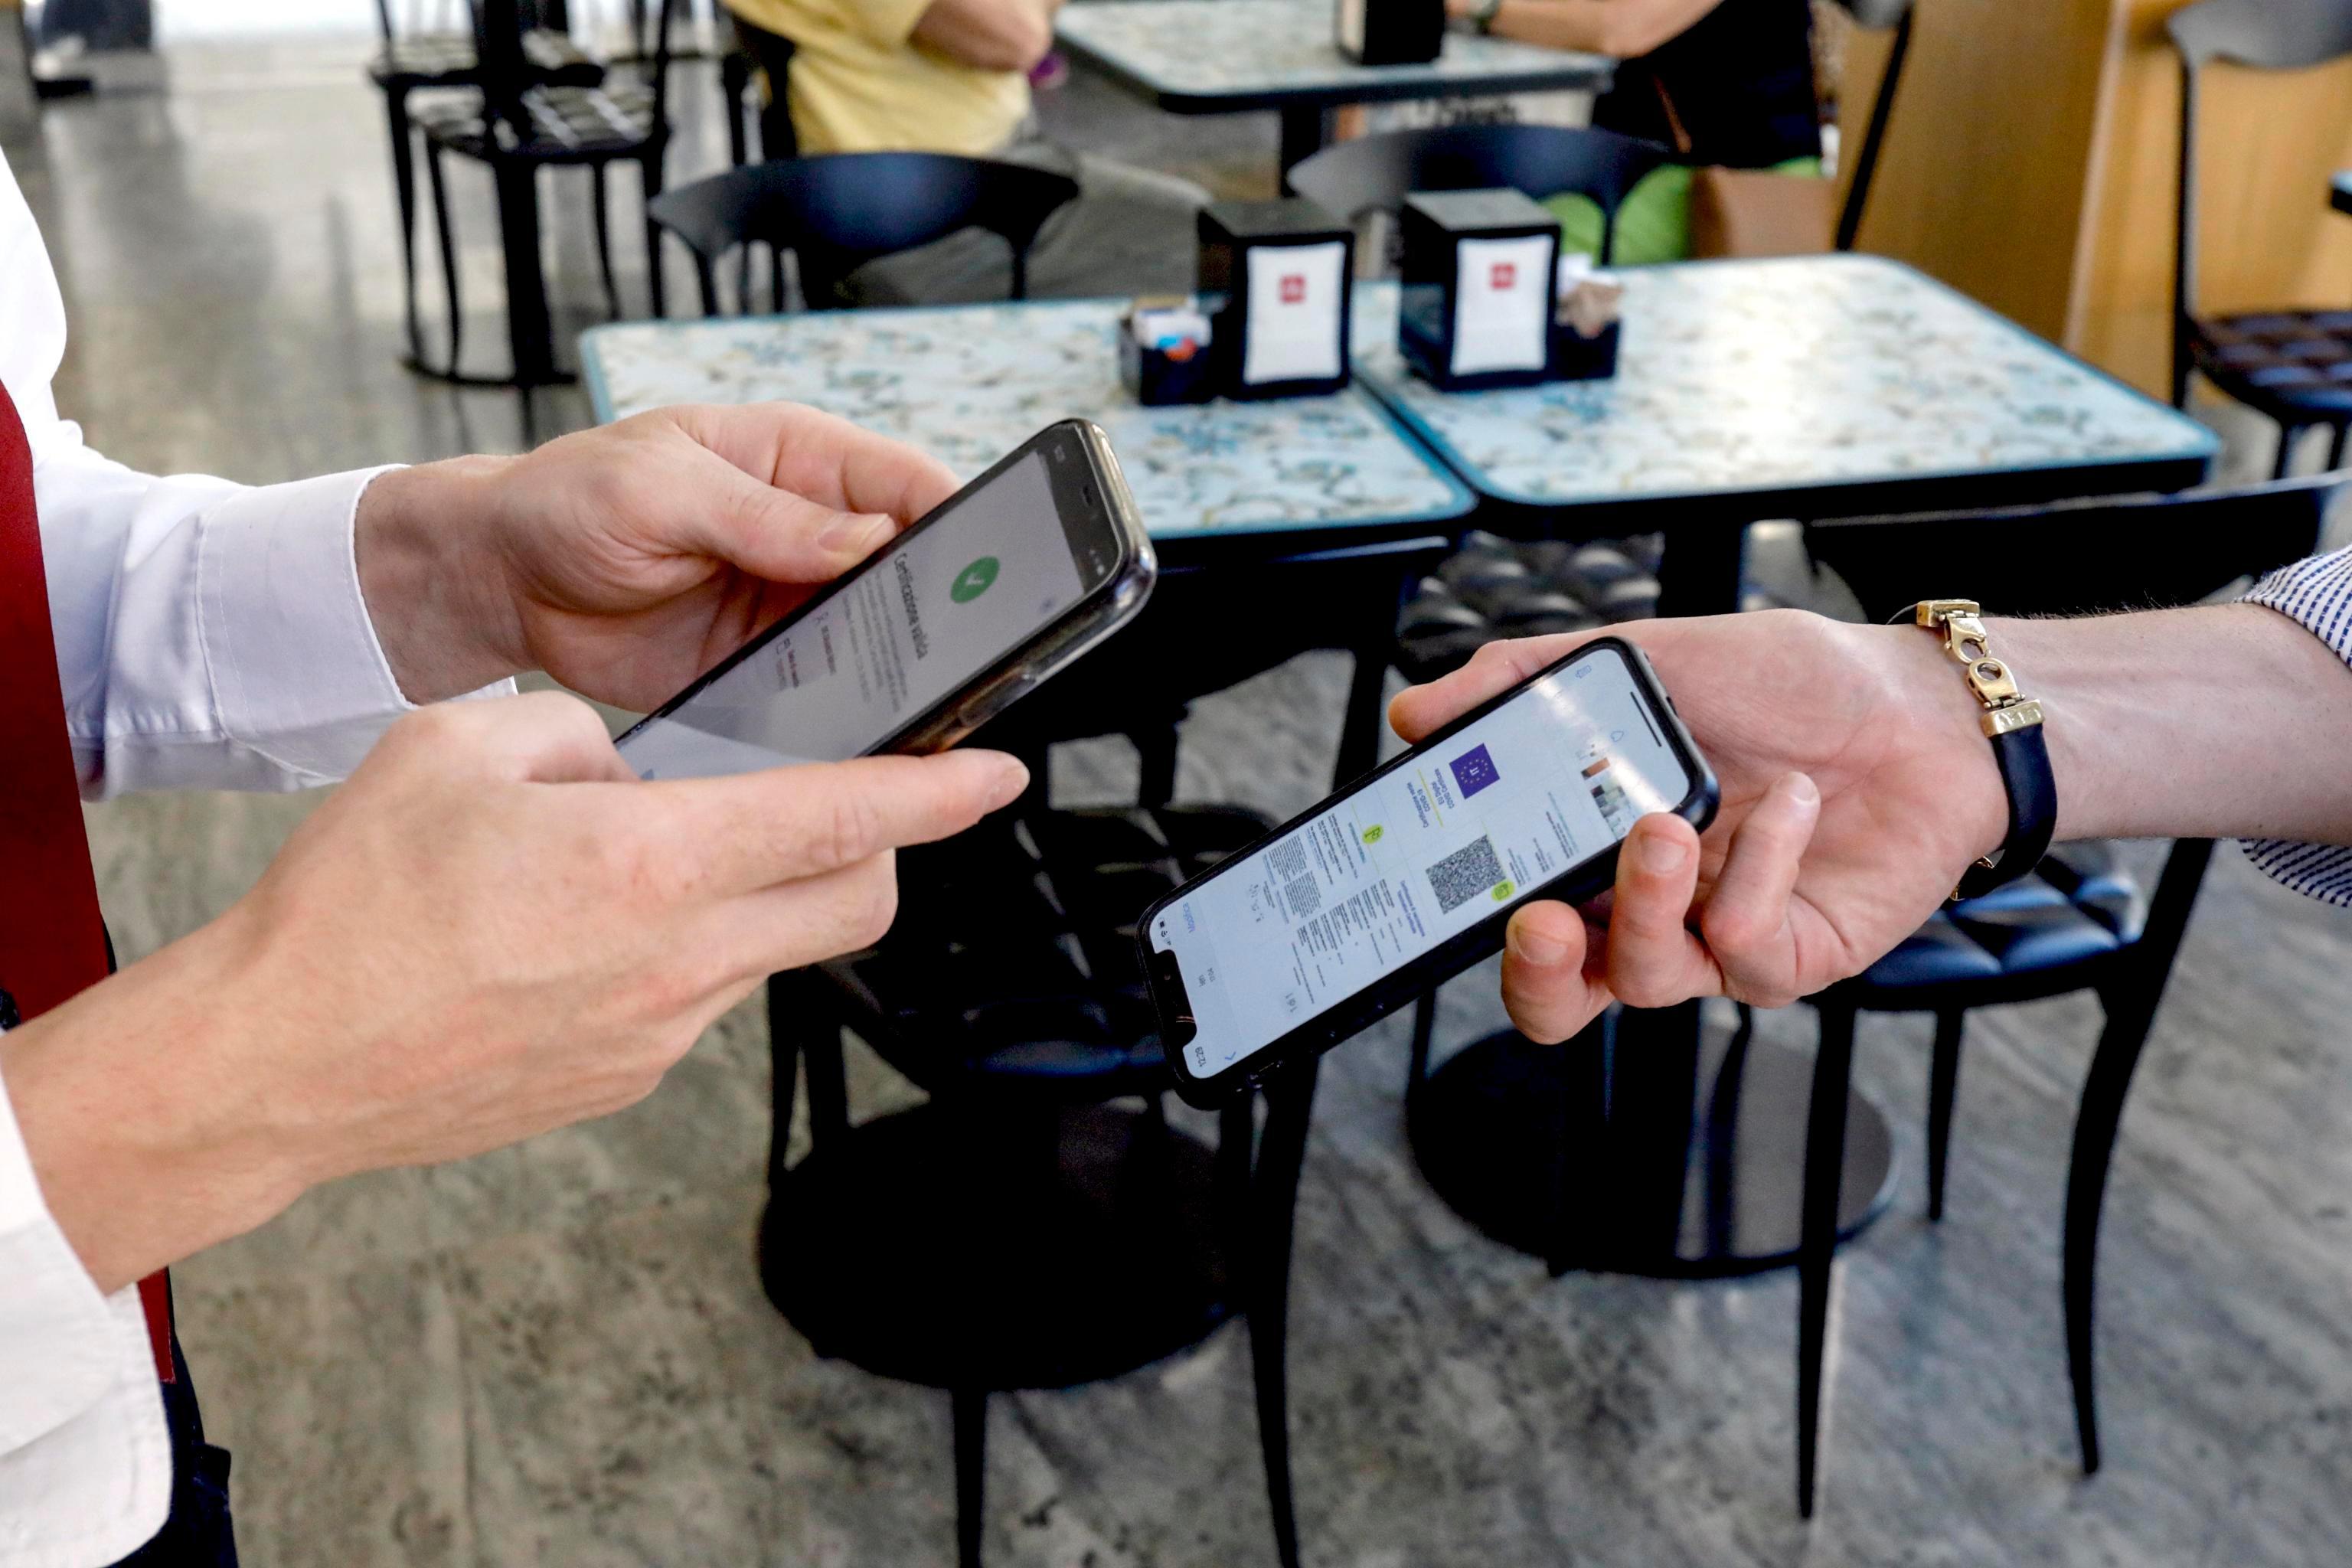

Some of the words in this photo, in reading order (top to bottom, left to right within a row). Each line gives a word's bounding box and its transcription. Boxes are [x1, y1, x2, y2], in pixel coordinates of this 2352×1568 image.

[894, 552, 920, 626] Certificazione
[912, 622, 929, 659] valida
[1468, 765, 1480, 776] IT
[1429, 779, 1442, 797] Digital
[1416, 787, 1431, 812] COVID-19
[1436, 795, 1445, 805] EU
[1443, 791, 1455, 809] COVID
[1410, 795, 1429, 828] Certificazione
[1181, 902, 1196, 933] Modifica
[1194, 1045, 1207, 1067] 12:29
